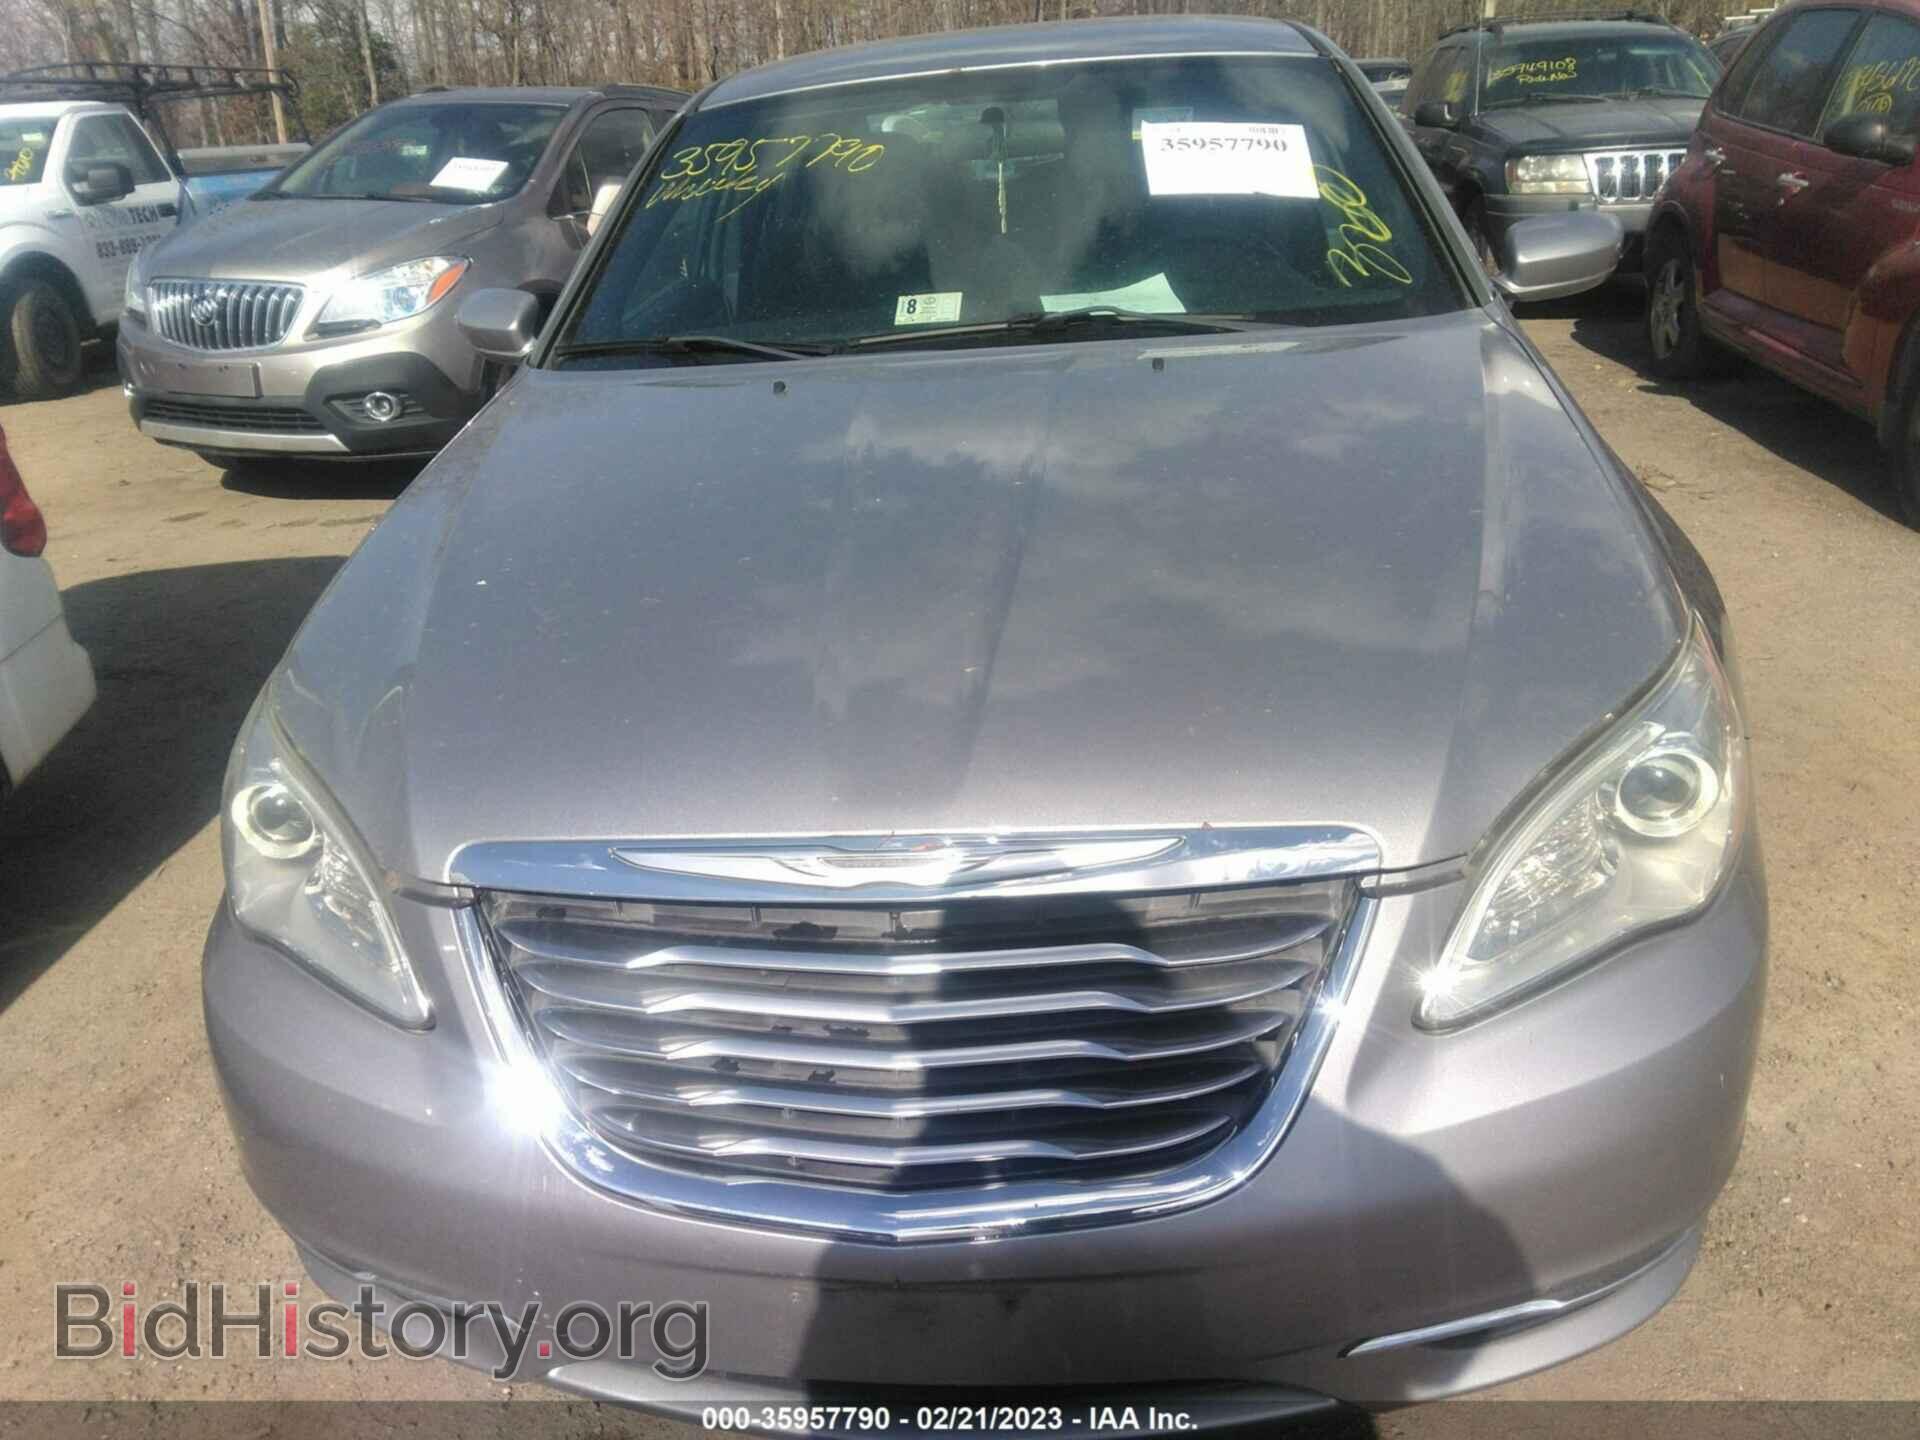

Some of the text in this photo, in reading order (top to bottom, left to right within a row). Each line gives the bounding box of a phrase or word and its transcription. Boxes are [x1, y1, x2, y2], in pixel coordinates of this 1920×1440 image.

[1159, 137, 1289, 153] 35957790
[660, 133, 885, 180] 35957790
[906, 298, 917, 315] 8
